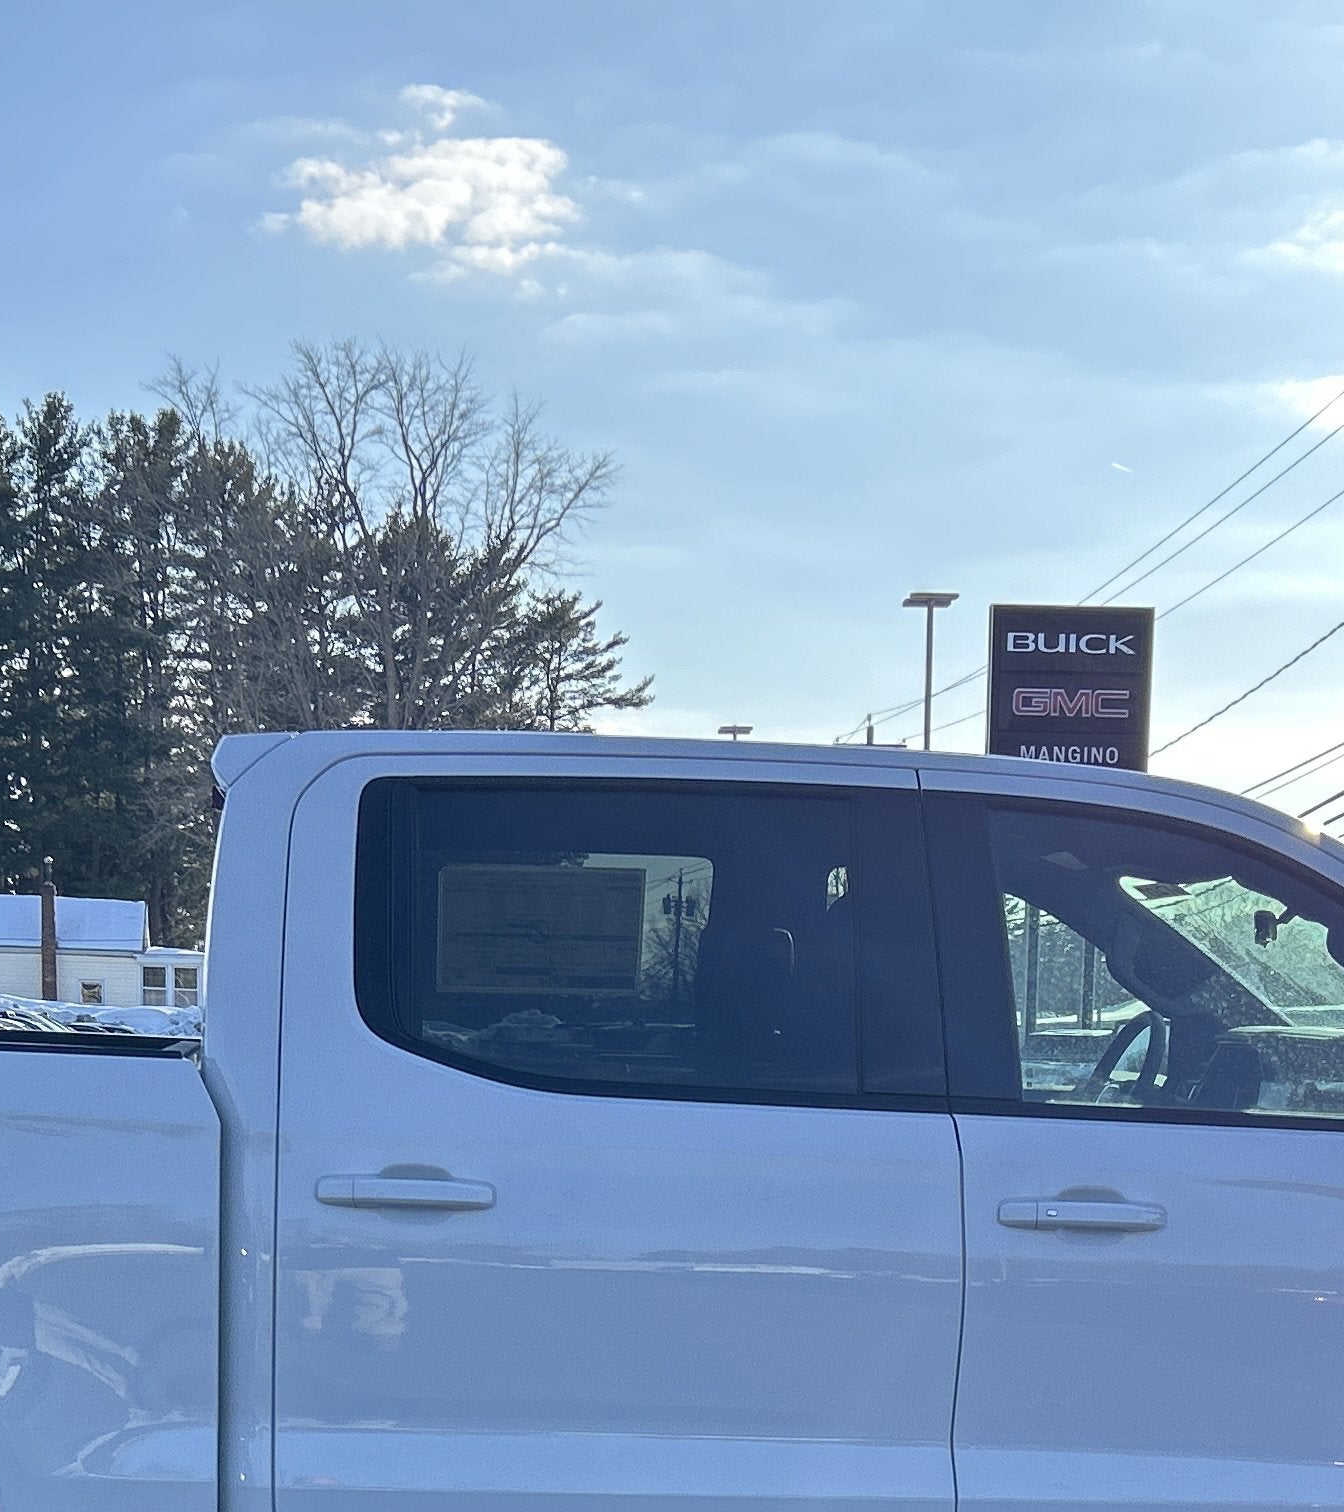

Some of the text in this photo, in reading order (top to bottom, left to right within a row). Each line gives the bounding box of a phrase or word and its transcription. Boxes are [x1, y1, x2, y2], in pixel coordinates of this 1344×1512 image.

[1006, 632, 1136, 655] BUICK
[1012, 687, 1130, 719] GMC
[1020, 745, 1119, 765] MANGINO
